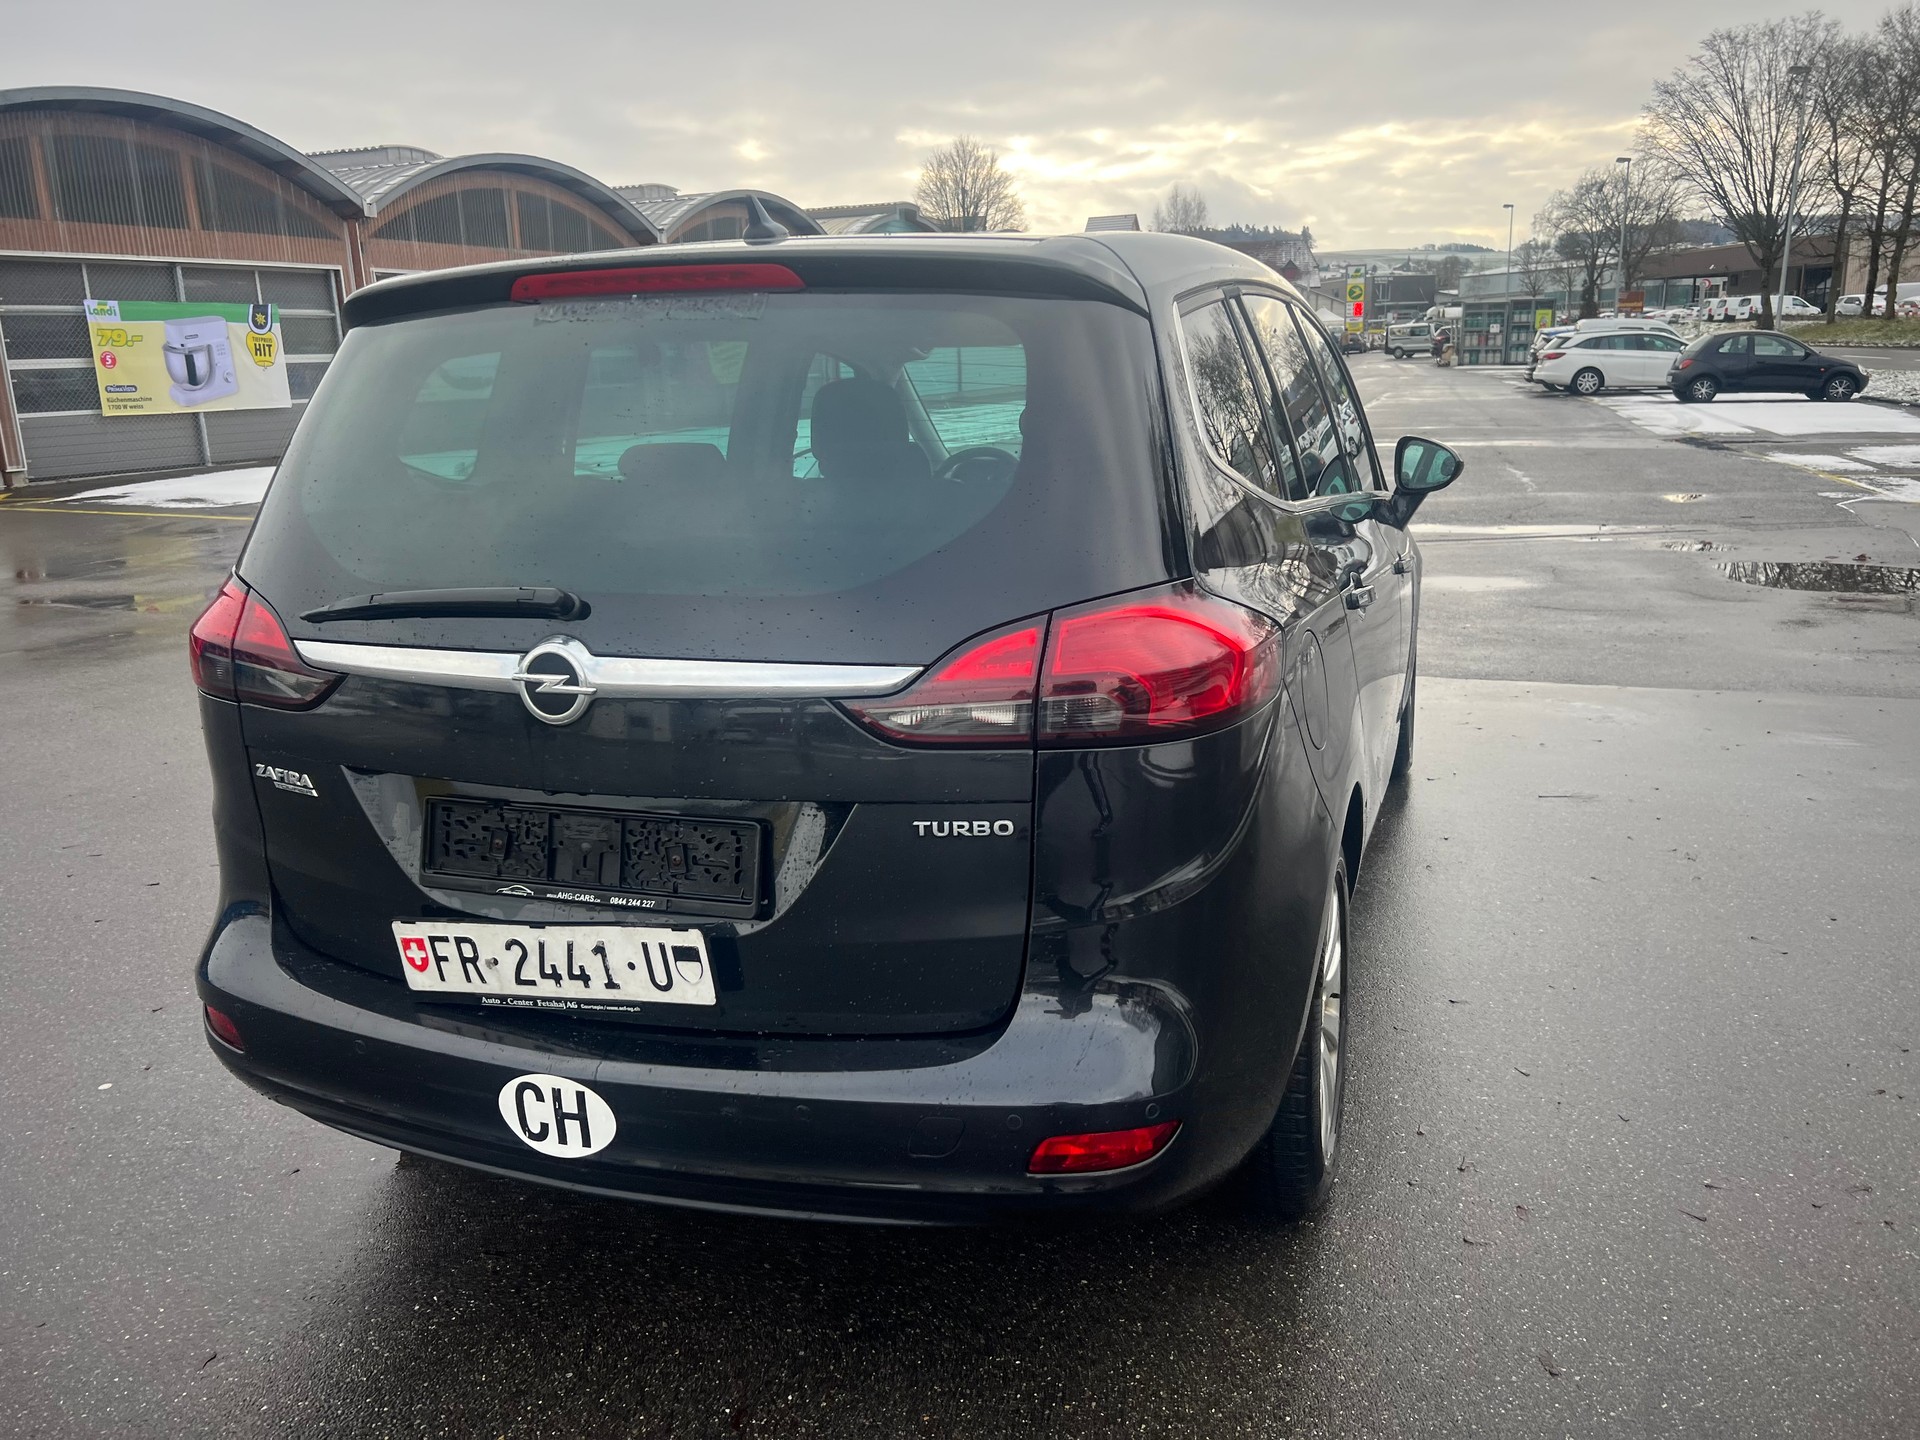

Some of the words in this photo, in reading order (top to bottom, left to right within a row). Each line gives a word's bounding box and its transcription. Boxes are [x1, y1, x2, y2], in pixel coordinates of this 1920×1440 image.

[87, 304, 117, 317] Landi
[96, 328, 143, 347] 79.-
[254, 343, 272, 357] HIT
[255, 763, 314, 789] ZAFIRA
[912, 819, 1014, 837] TURBO
[610, 896, 627, 905] 0844
[627, 898, 641, 907] 244
[641, 900, 656, 908] 227
[481, 996, 501, 1004] Auto
[507, 997, 534, 1007] Center
[536, 999, 566, 1010] Fetahaj
[566, 1001, 578, 1009] AG
[514, 1081, 592, 1149] CH
